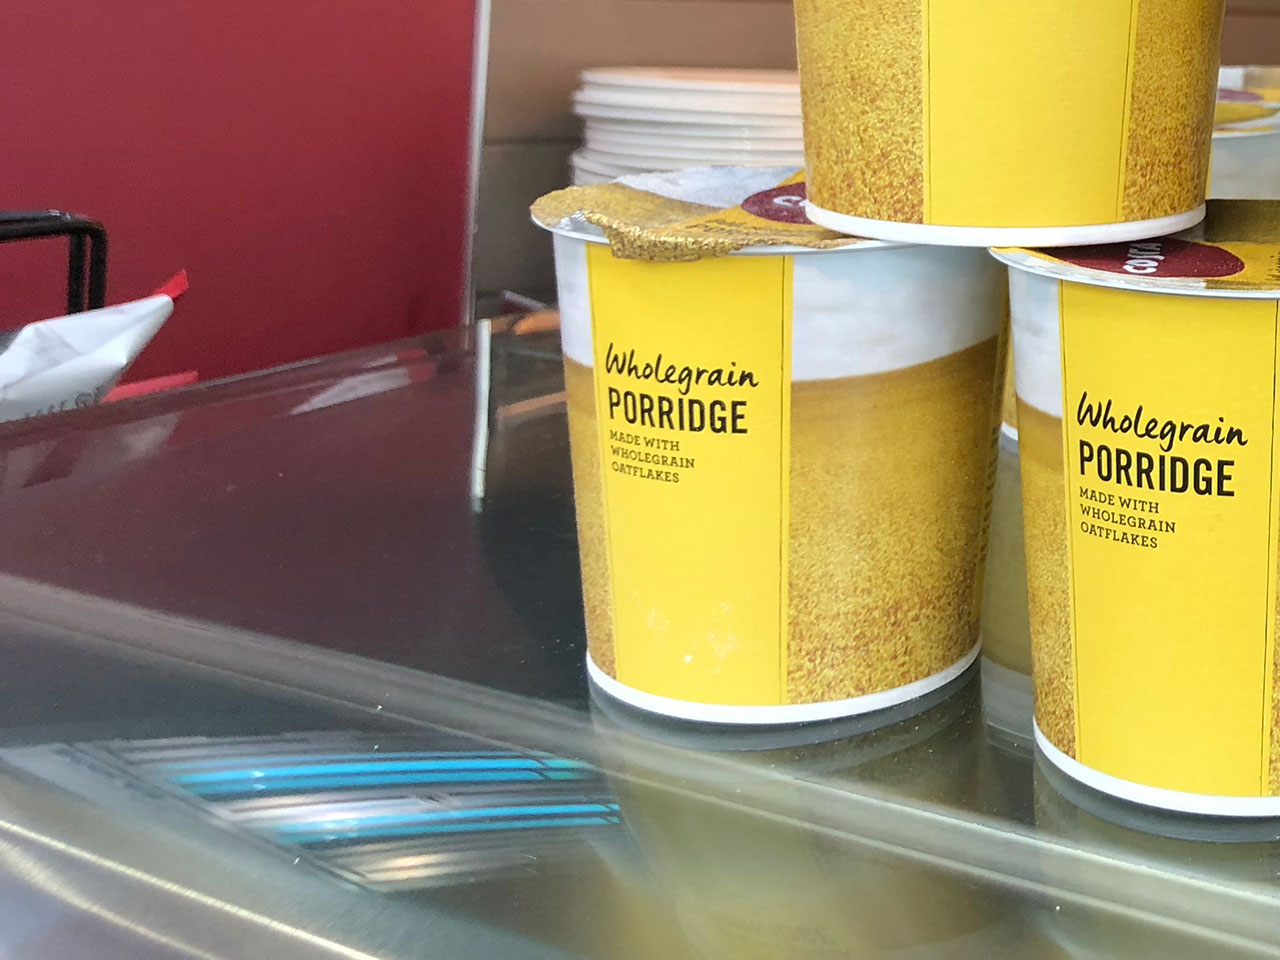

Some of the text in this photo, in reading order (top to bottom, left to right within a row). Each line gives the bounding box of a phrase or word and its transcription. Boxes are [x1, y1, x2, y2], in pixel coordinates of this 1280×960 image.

[605, 342, 759, 396] Wholegrain
[608, 386, 748, 434] PORRIDGE
[1076, 391, 1249, 453] Wholegrain
[610, 431, 680, 451] MADE WITH
[611, 447, 695, 468] WHOLEGRAIN
[612, 461, 680, 483] OATFLAKES
[1079, 439, 1235, 497] PORRIDGE
[1079, 486, 1160, 514] MADE WITH
[1080, 504, 1176, 534] WHOLEGRAIN
[1080, 521, 1158, 549] OATFLAKES
